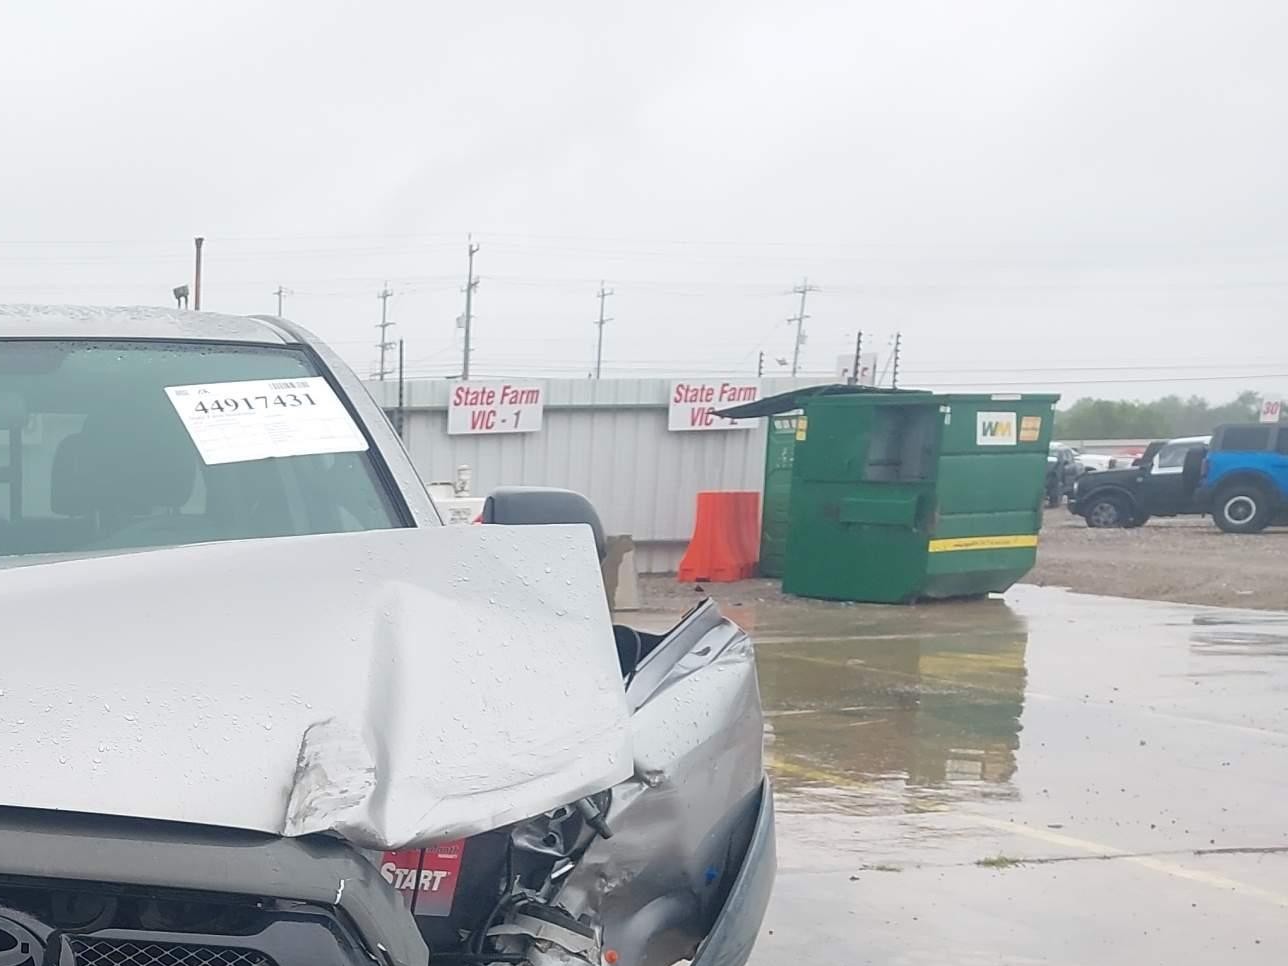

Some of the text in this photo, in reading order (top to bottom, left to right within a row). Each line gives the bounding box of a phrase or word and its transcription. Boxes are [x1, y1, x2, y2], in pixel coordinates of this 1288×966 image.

[453, 385, 540, 406] State Farm
[674, 383, 757, 403] State Farm
[194, 393, 317, 414] 44917431
[471, 410, 496, 430] VIC
[513, 410, 521, 428] 1
[982, 420, 1011, 437] WM
[380, 862, 448, 891] START
